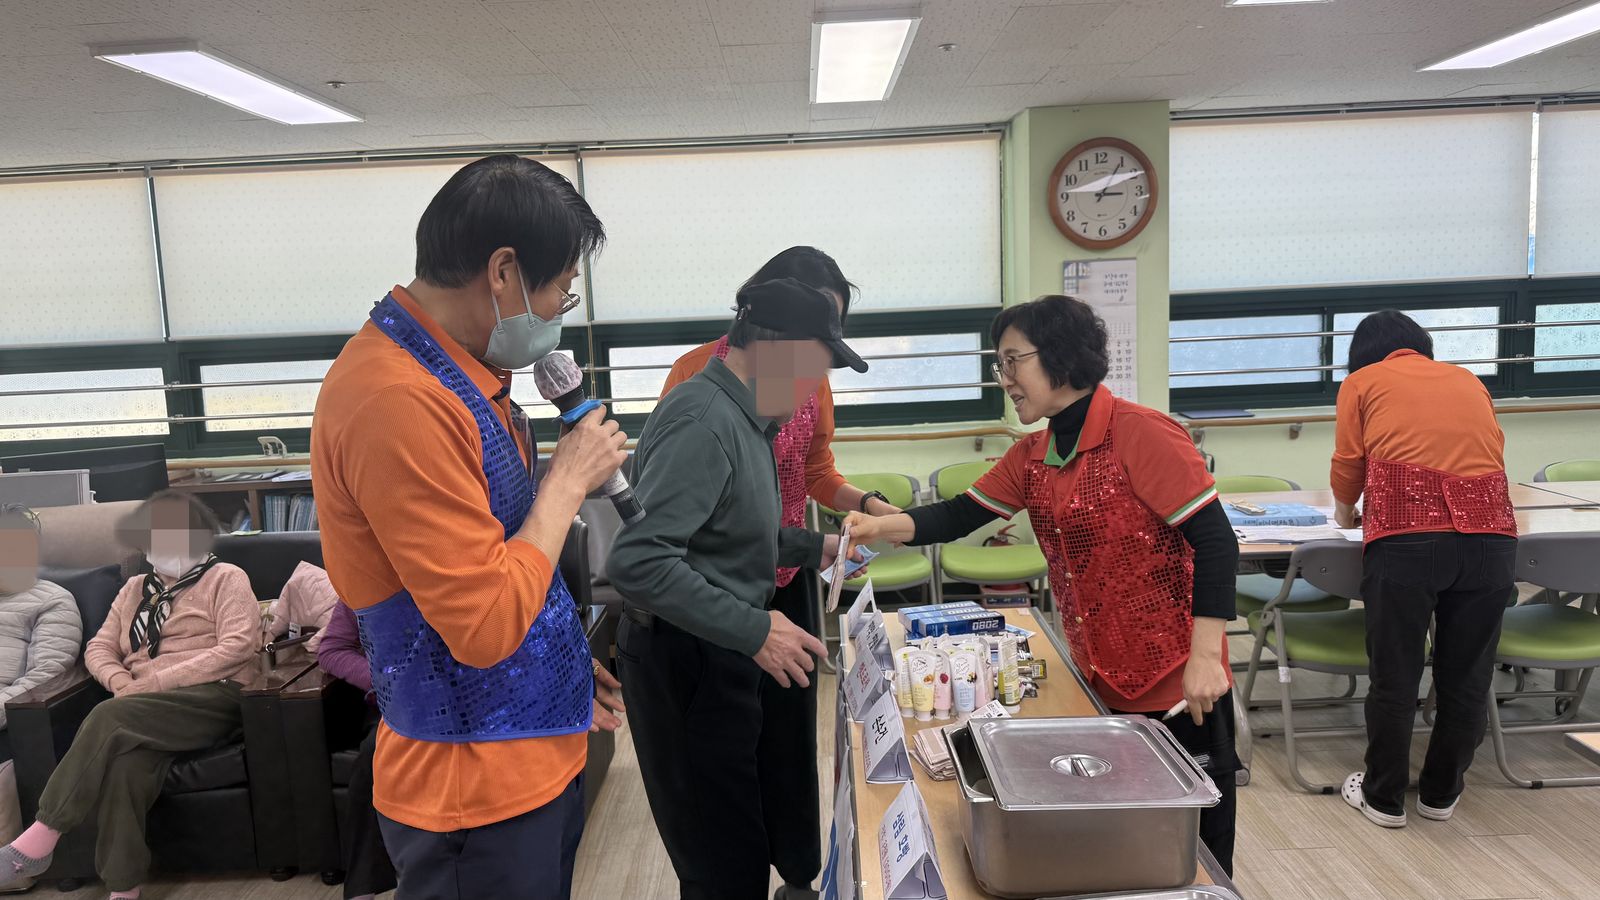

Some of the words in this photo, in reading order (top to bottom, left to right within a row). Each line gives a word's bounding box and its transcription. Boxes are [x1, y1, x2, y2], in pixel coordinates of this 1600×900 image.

[1094, 151, 1108, 165] 12
[1120, 155, 1124, 168] 1
[1078, 159, 1089, 172] 11
[1064, 174, 1078, 187] 10
[1060, 191, 1070, 204] 9
[1135, 184, 1144, 198] 3
[1066, 210, 1076, 222] 8
[1130, 204, 1138, 217] 4
[1080, 221, 1089, 234] 7
[1118, 218, 1127, 230] 5
[1098, 225, 1108, 237] 6
[972, 619, 999, 631] 2080
[871, 713, 889, 746] 손수건
